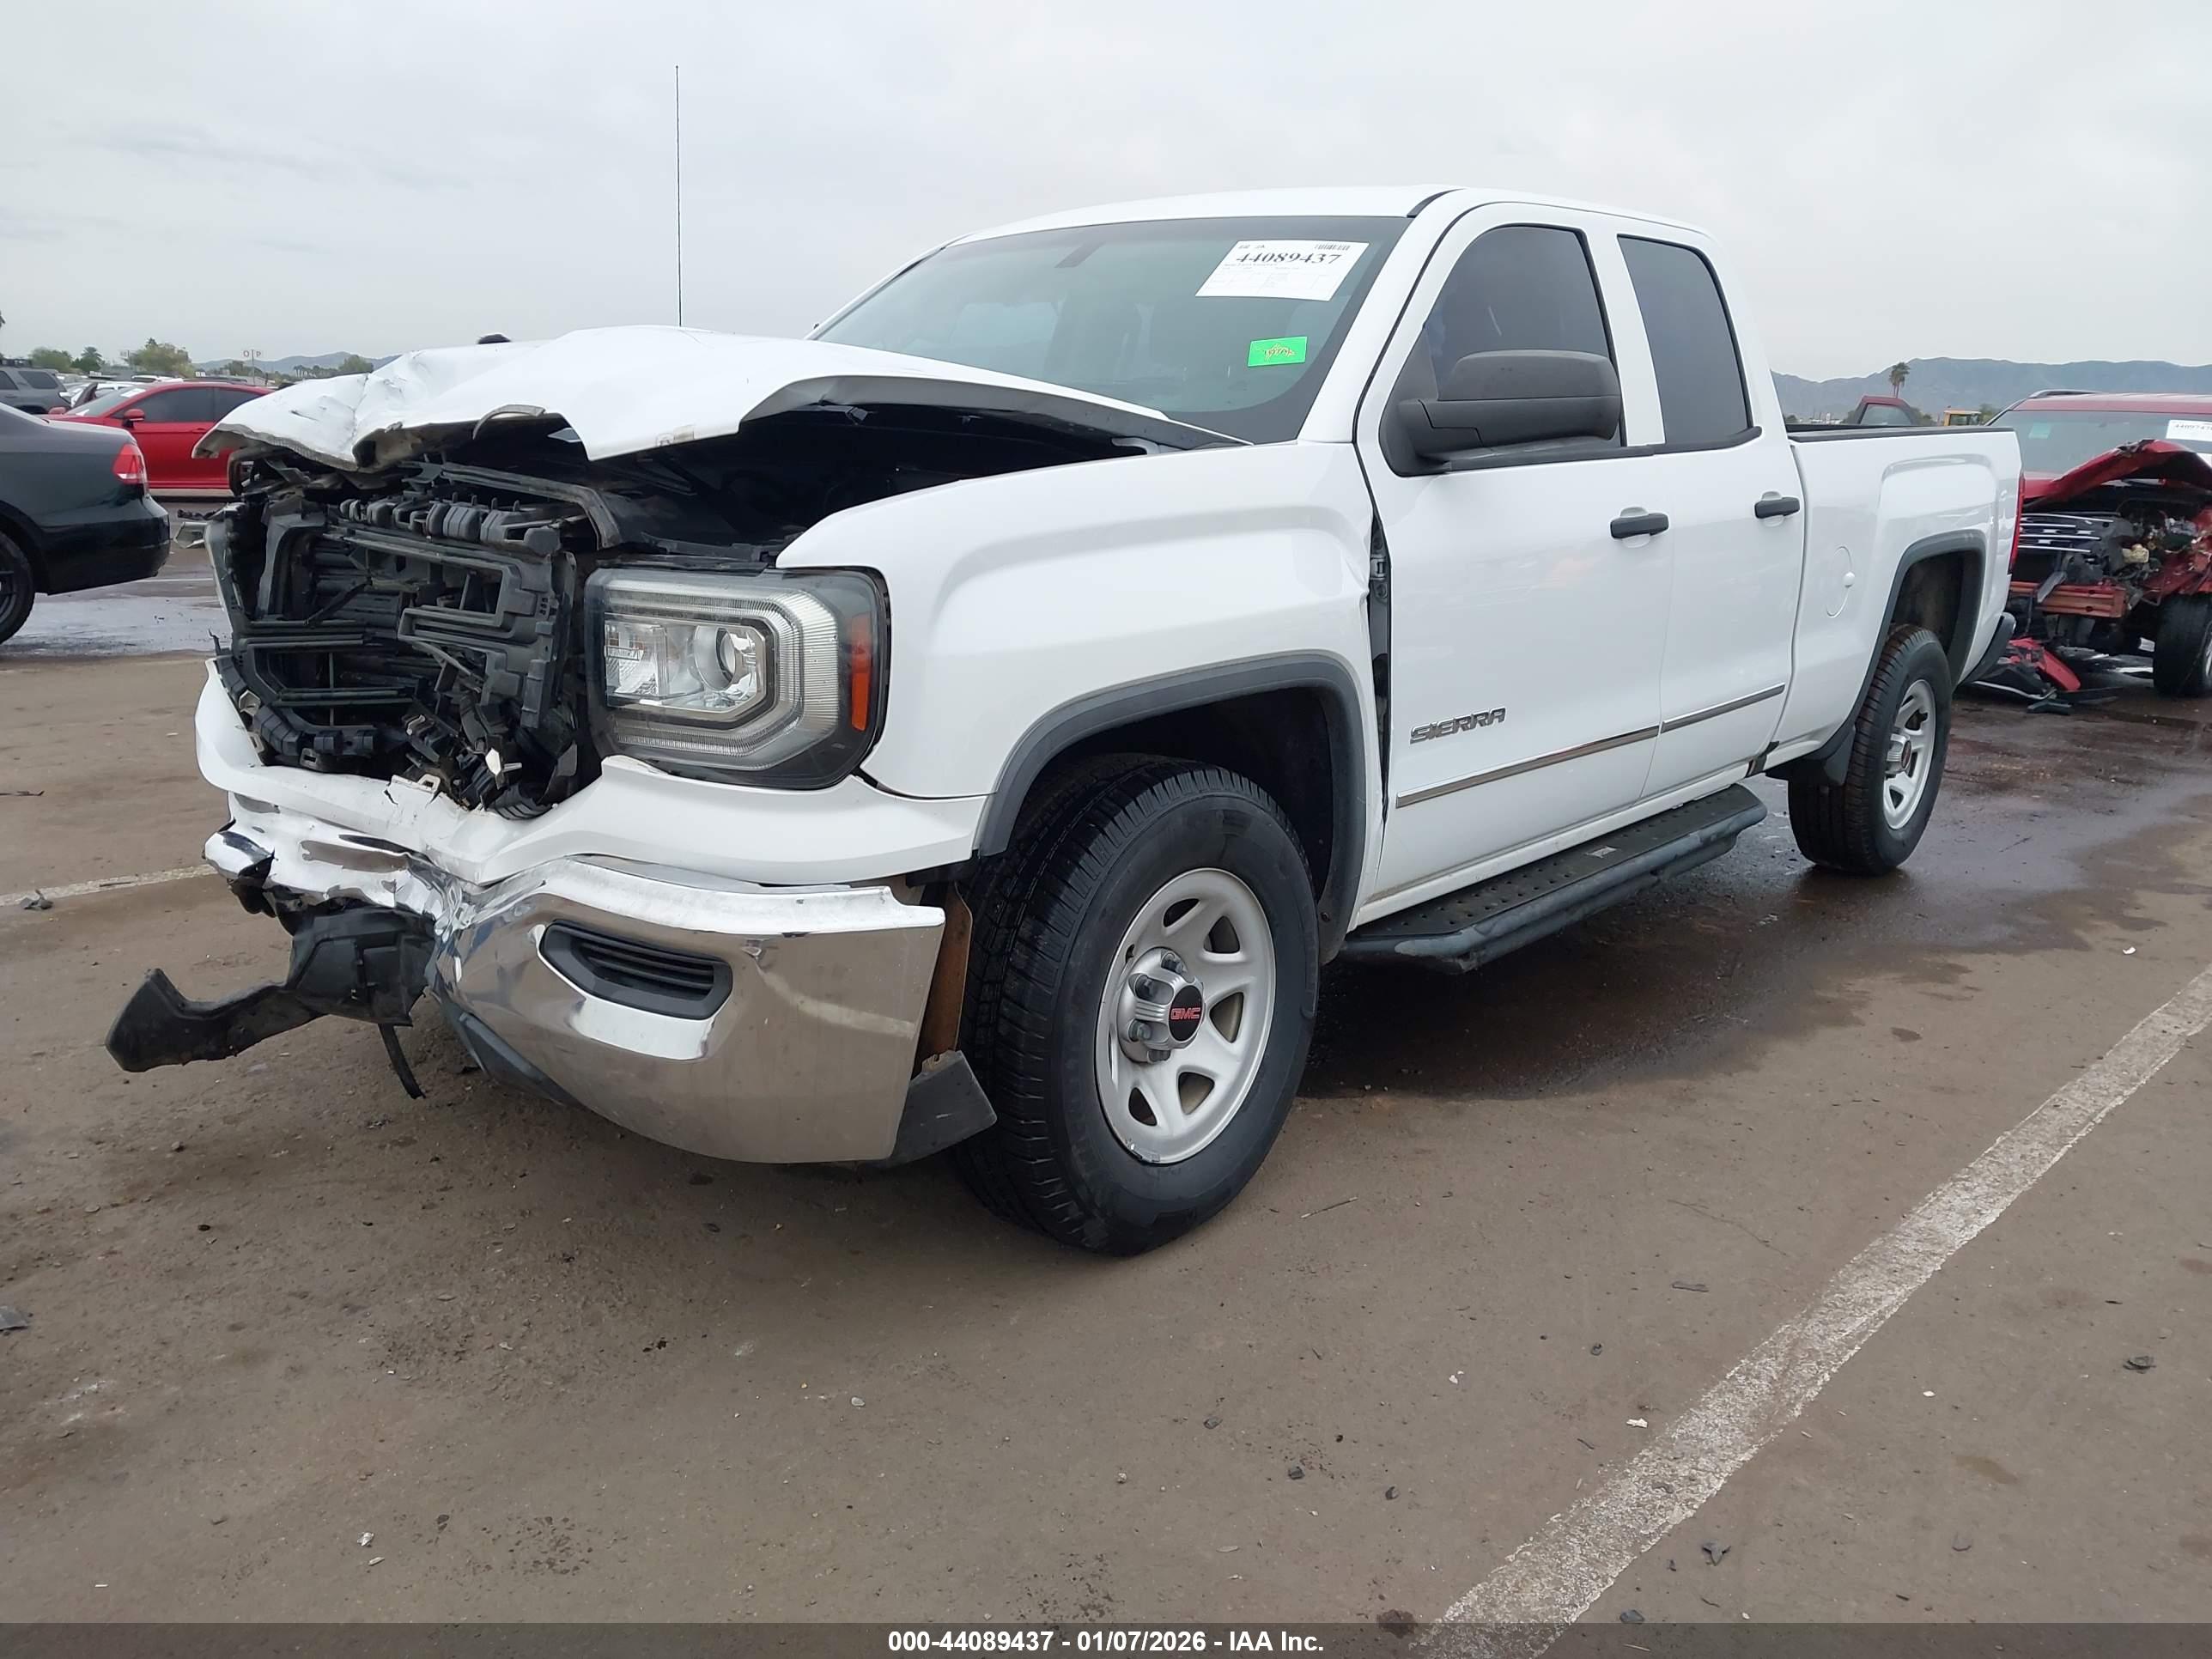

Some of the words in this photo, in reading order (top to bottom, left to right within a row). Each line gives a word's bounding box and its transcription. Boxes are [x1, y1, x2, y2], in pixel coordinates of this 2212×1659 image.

[1237, 252, 1342, 264] 44089437
[1409, 707, 1506, 744] SIERRA
[1170, 1007, 1200, 1020] GMC
